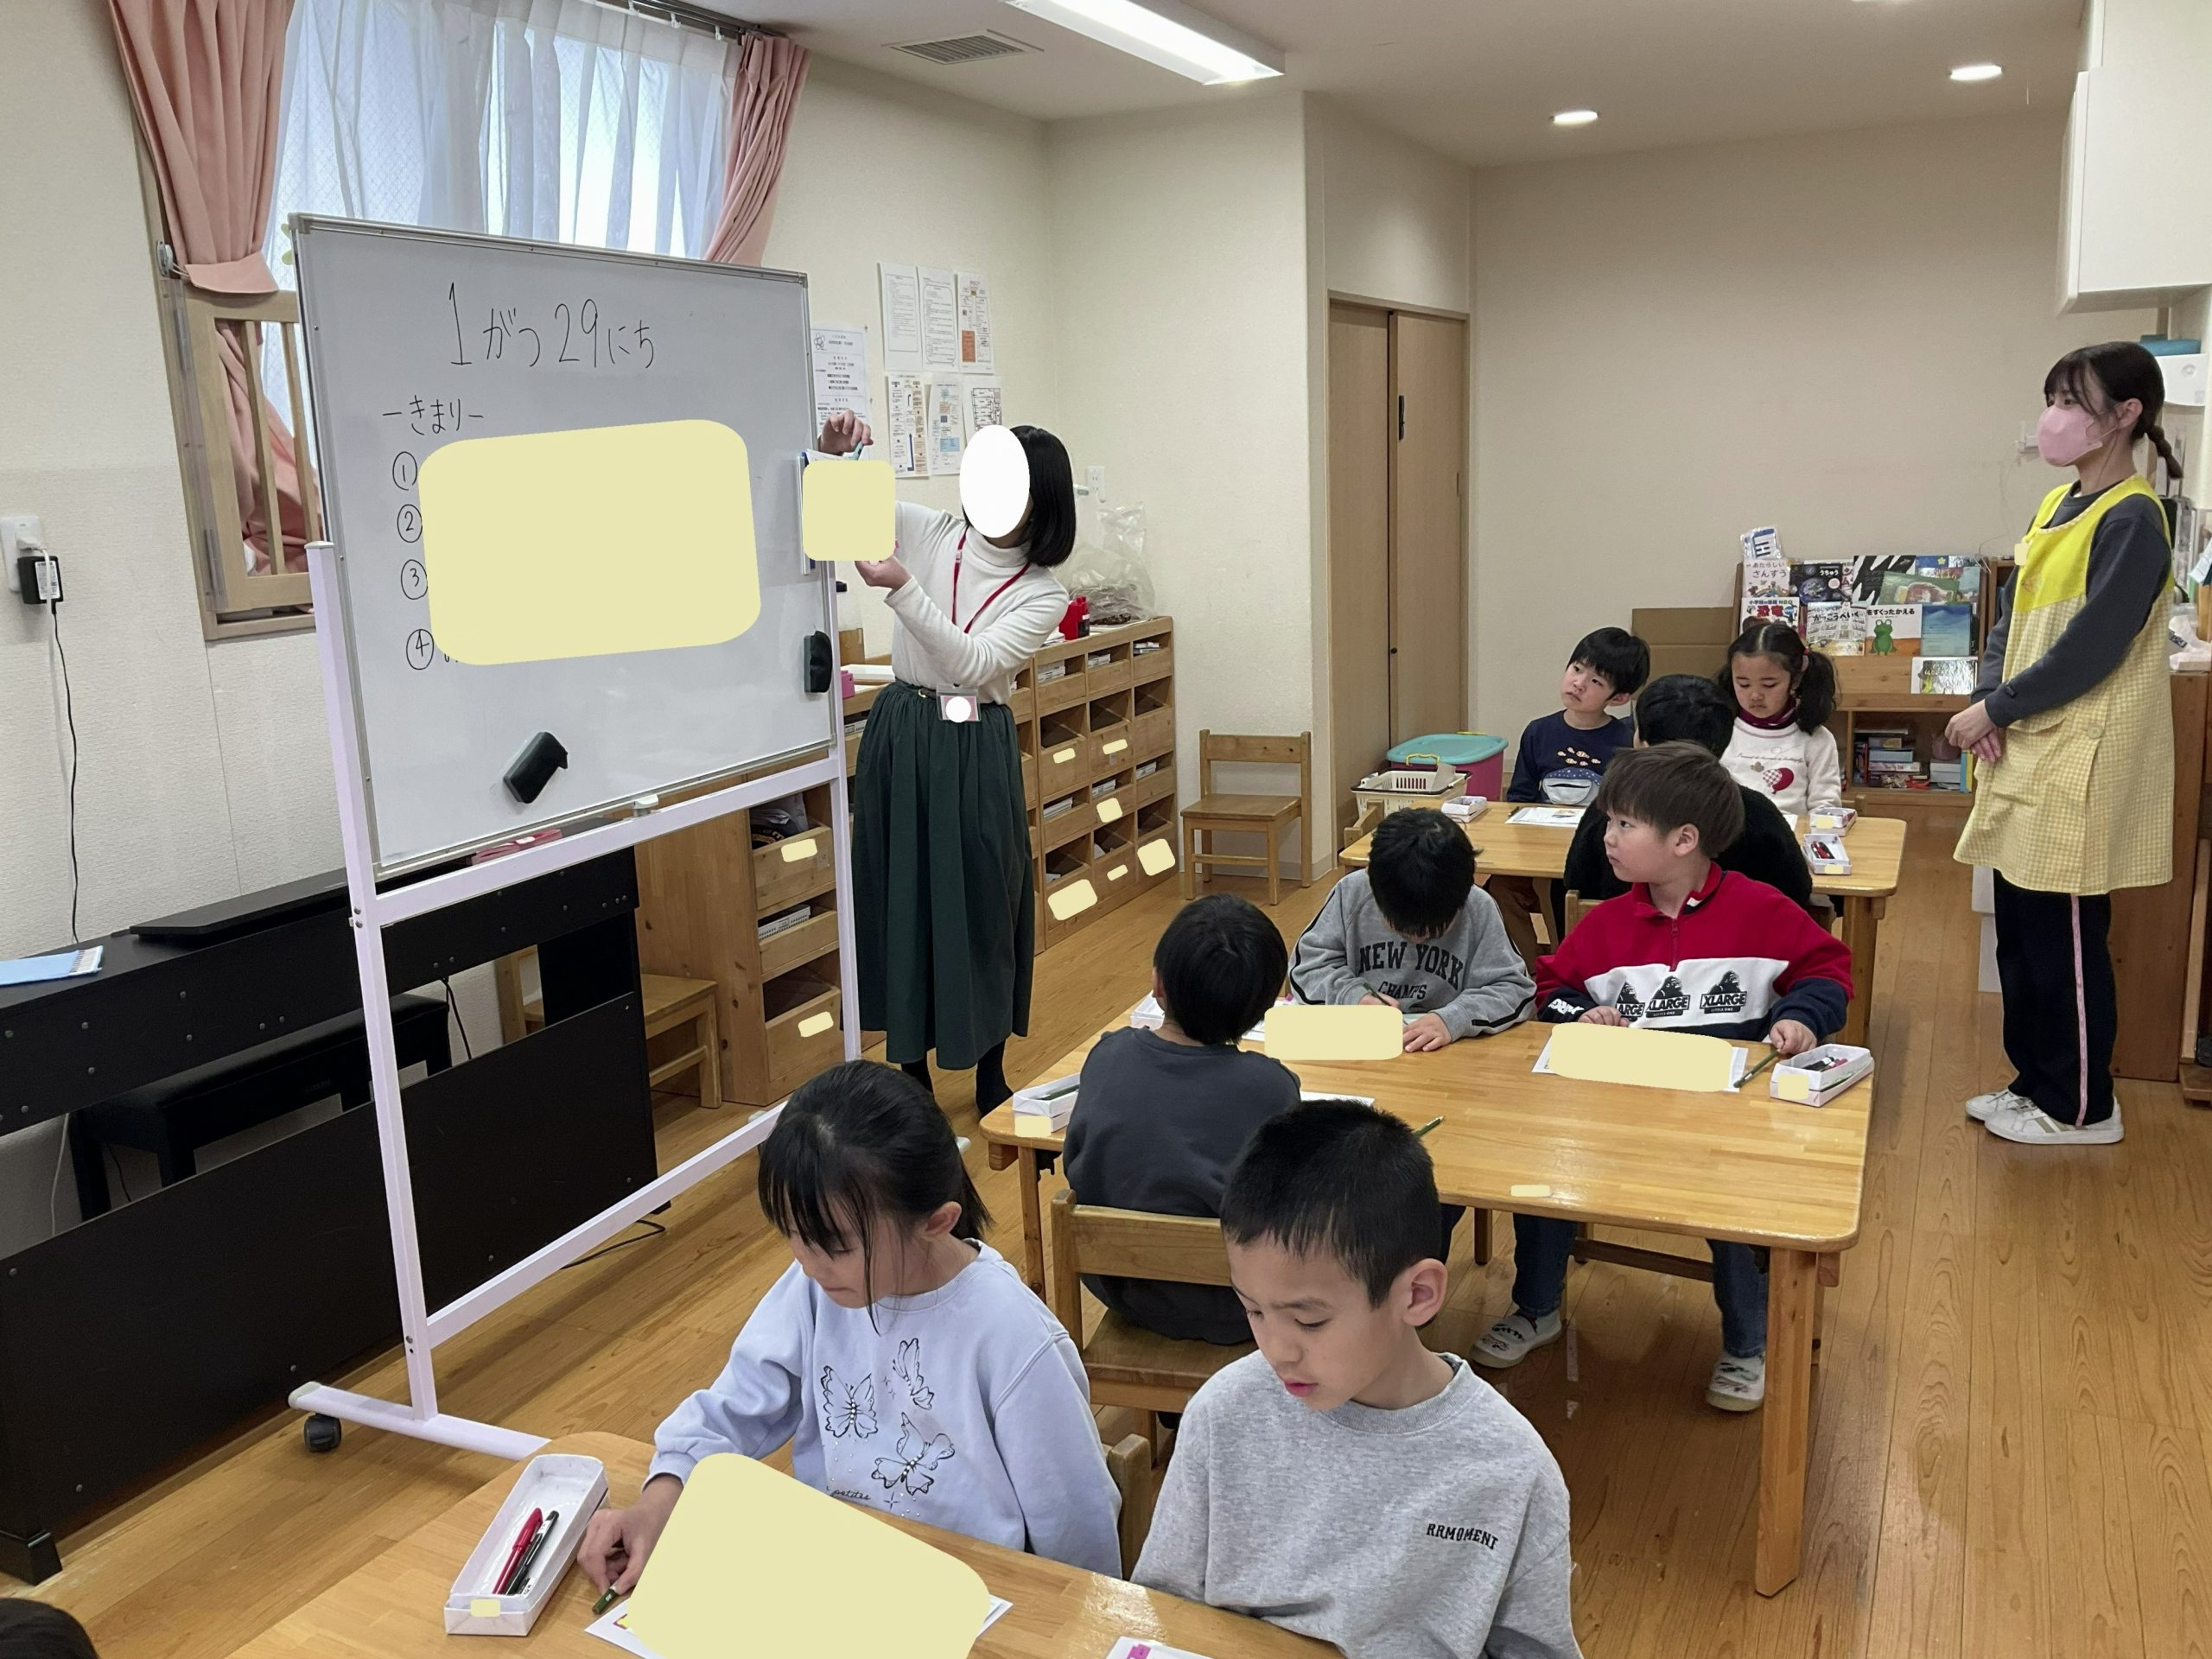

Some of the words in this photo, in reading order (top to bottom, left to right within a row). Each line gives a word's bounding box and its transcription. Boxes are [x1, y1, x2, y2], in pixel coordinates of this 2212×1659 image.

[1751, 569, 1788, 579] さんすう
[1358, 940, 1408, 976] NEW
[1414, 943, 1464, 991] YORK
[1377, 981, 1427, 1000] CHAMPS
[1701, 993, 1746, 1007] XLARGE
[1426, 1522, 1498, 1550] RRMOMENT
